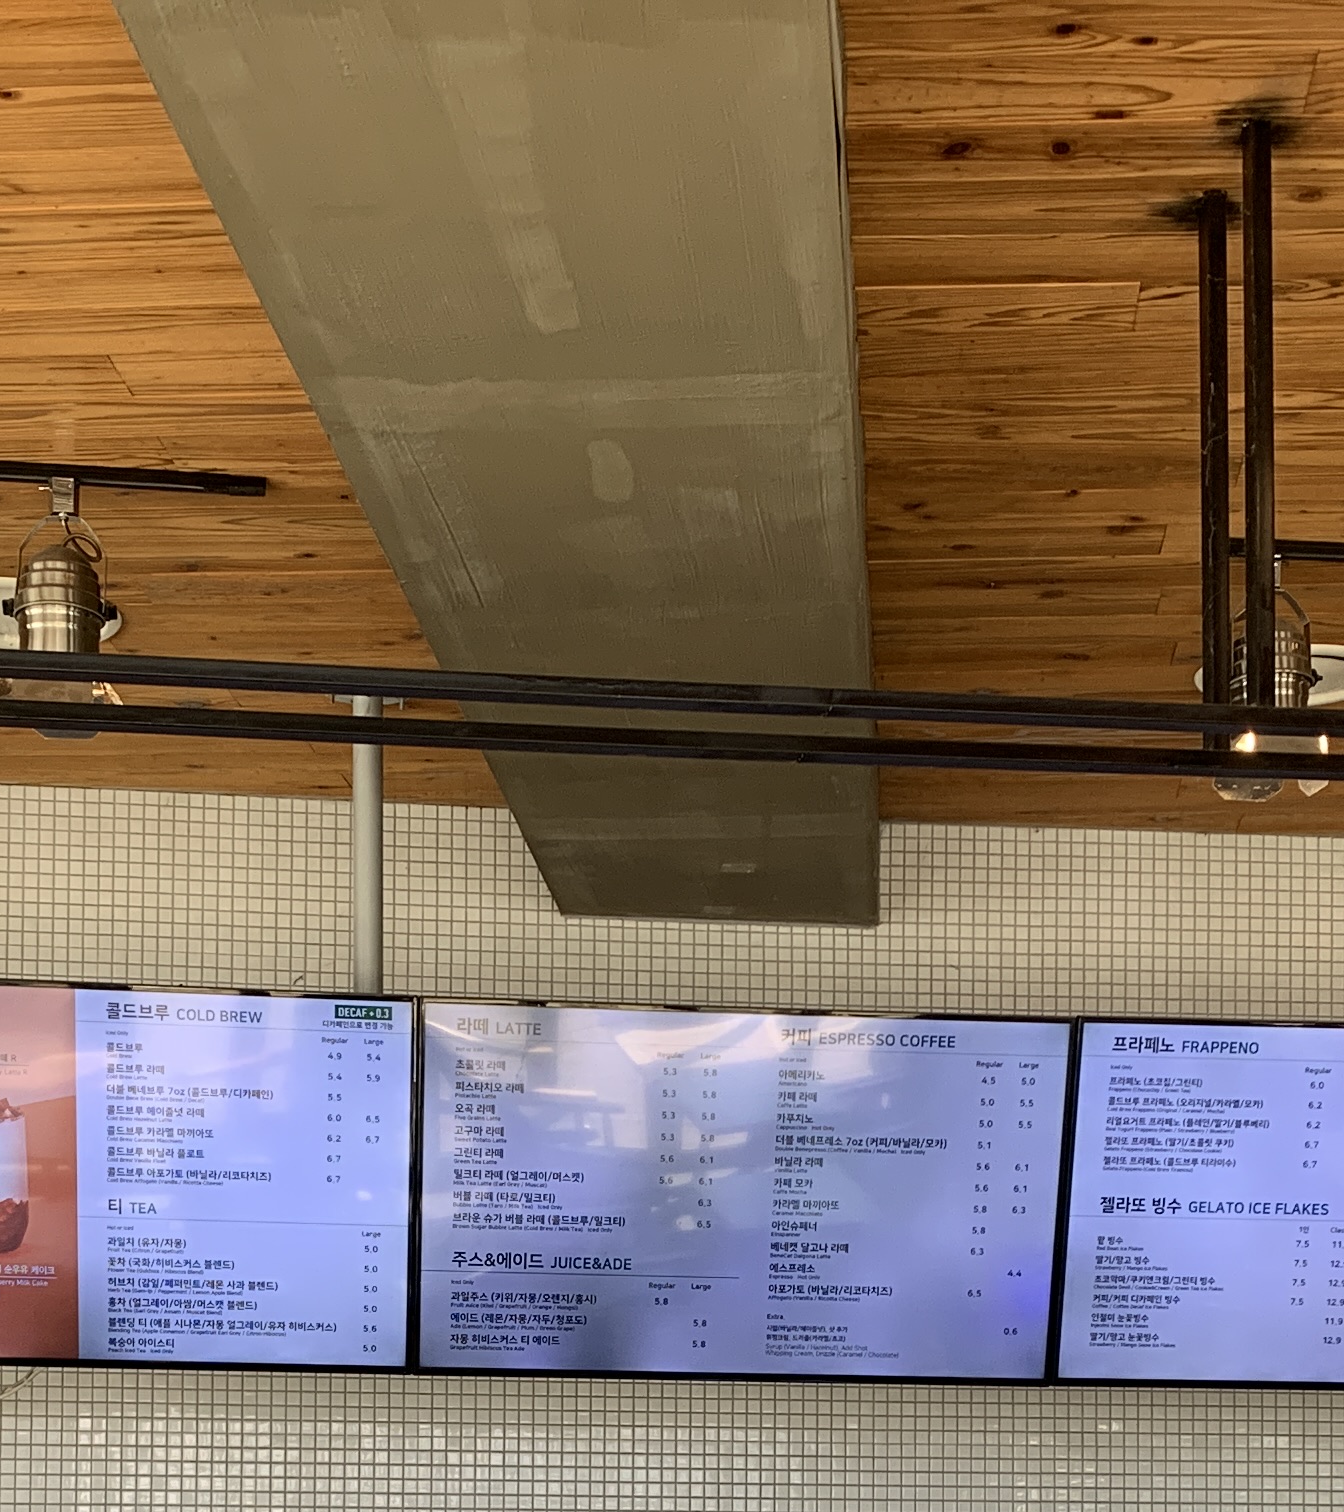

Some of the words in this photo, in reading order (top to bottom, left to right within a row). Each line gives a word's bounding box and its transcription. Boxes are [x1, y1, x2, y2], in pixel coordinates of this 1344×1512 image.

[106, 1002, 170, 1020] 콜드브루
[177, 1008, 215, 1022] COLD
[220, 1010, 262, 1023] BREW
[456, 1018, 489, 1035] 라떼
[496, 1021, 541, 1035] LATTE
[781, 1028, 811, 1046] 커피
[819, 1032, 895, 1045] ESPRESSO
[900, 1034, 956, 1048] COFFEE
[1112, 1036, 1175, 1053] 프라페노
[1182, 1041, 1259, 1054] FRAPPENO
[106, 1064, 143, 1074] 콜드브루
[146, 1064, 165, 1075] 라떼
[328, 1073, 342, 1081] 5.4
[366, 1074, 380, 1083] 5.9
[778, 1070, 825, 1081] 아메리카노
[982, 1077, 996, 1085] 4.5
[1021, 1078, 1035, 1086] 5.0
[455, 1081, 503, 1093] 피스타치오
[505, 1082, 524, 1094] 라떼
[662, 1090, 676, 1098] 5.3
[703, 1091, 716, 1099] 5.8
[108, 1199, 122, 1214] 티
[130, 1202, 157, 1214] TEA
[1100, 1197, 1146, 1214] 젤라또
[1152, 1198, 1182, 1214] 빙수
[1189, 1202, 1244, 1215] GELATO
[1249, 1202, 1270, 1215] ICE
[1276, 1203, 1329, 1216] FLAKES
[452, 1252, 544, 1269] 주스&에이드
[550, 1256, 632, 1270] JUICE&ADE
[769, 1263, 815, 1274] 에스프레소
[1008, 1269, 1021, 1278] 4.4
[108, 1338, 135, 1348] 복숭아
[138, 1338, 174, 1348] 아이스티
[363, 1344, 377, 1352] 5.0
[451, 1335, 468, 1345] 자몽
[471, 1335, 518, 1345] 히비스커스
[521, 1336, 529, 1345] 티
[532, 1336, 560, 1346] 에이드
[692, 1340, 706, 1348] 5.8
